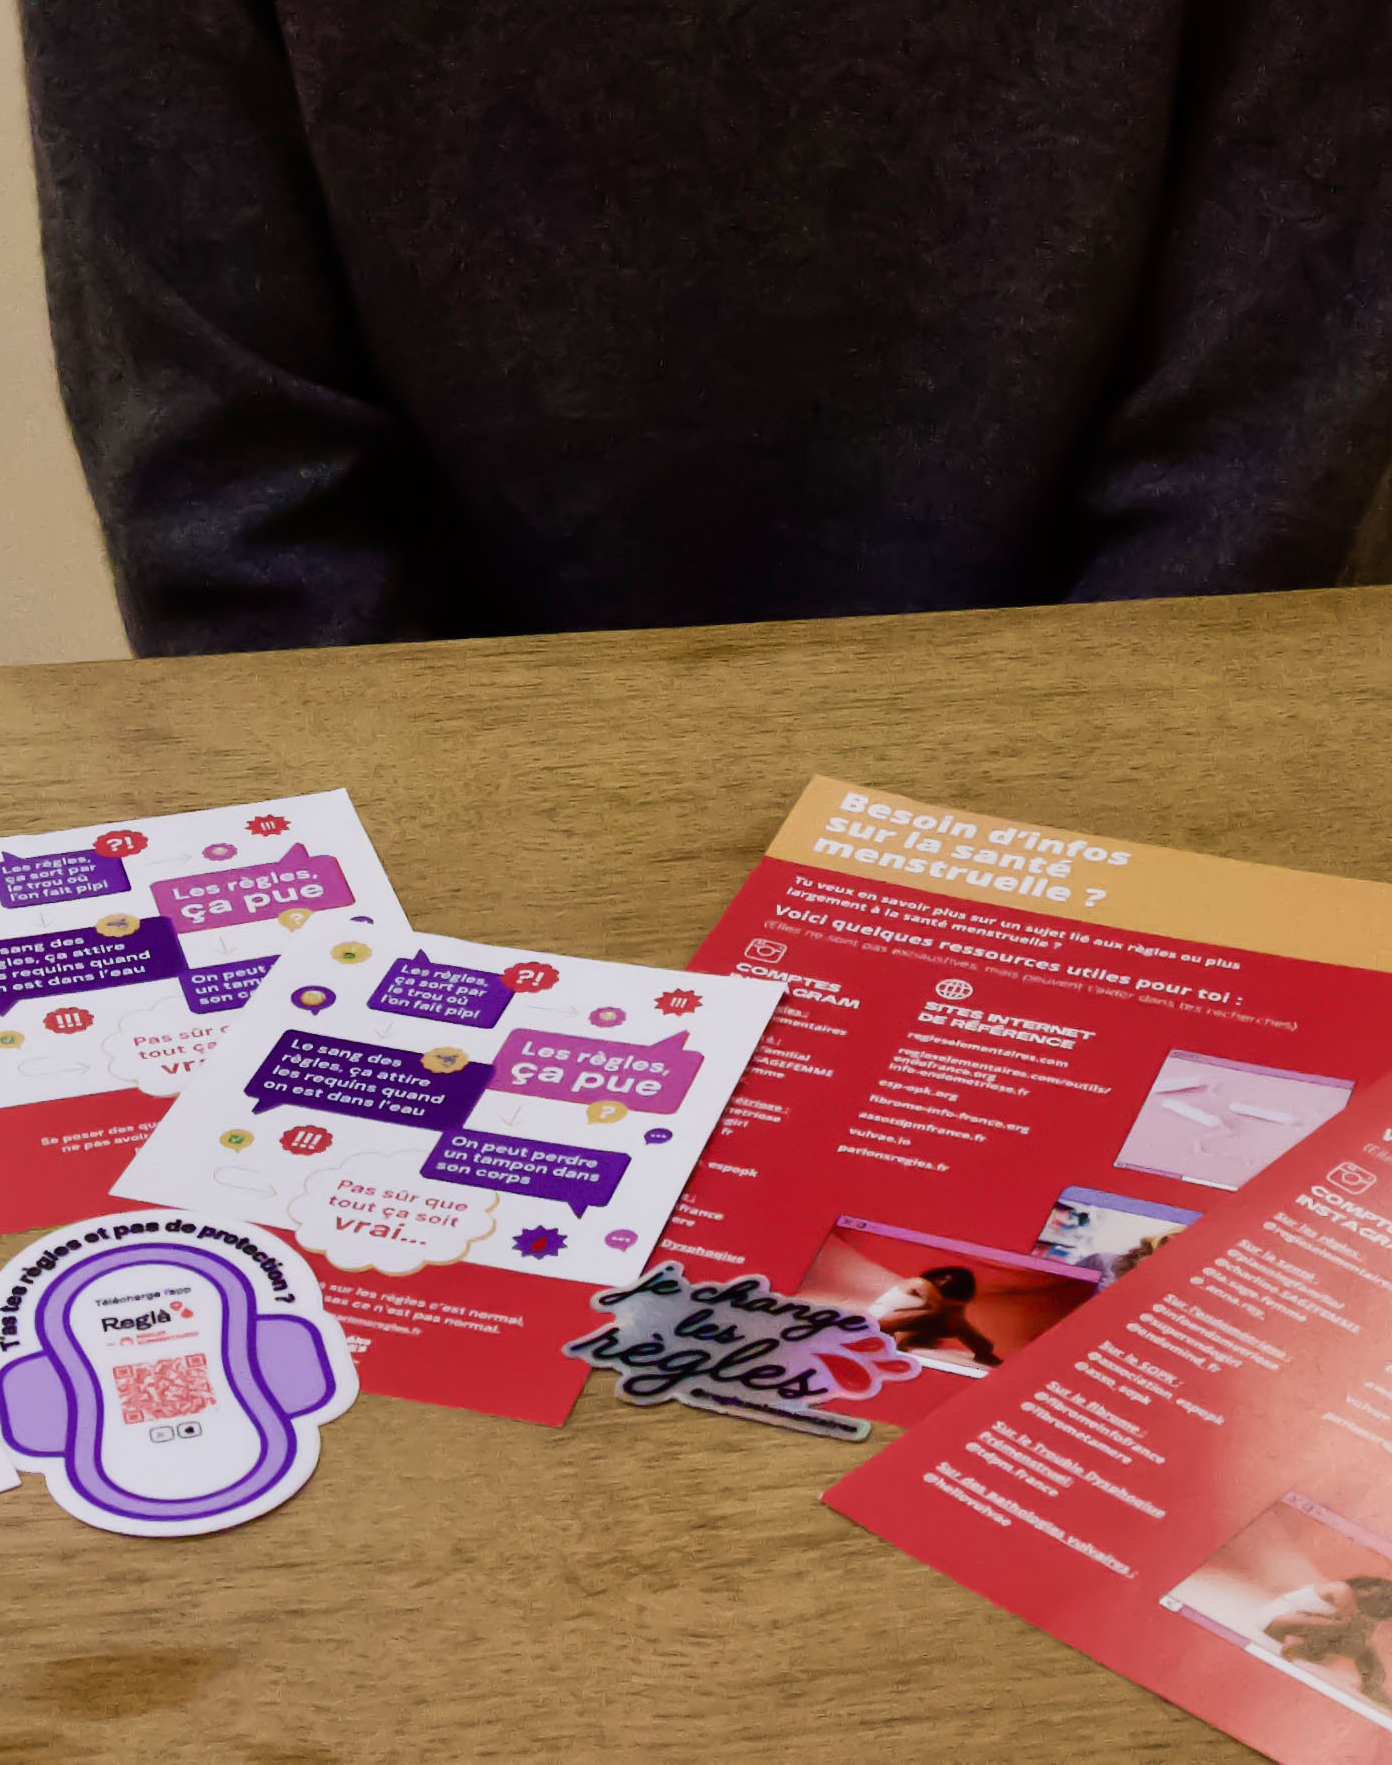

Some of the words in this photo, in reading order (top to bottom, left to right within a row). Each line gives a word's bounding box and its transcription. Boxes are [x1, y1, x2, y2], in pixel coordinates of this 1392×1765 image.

[838, 791, 977, 839] Besoin
[824, 816, 897, 843] sur
[902, 830, 942, 854] la
[950, 844, 1072, 878] santé
[172, 883, 220, 900] Les
[226, 869, 318, 891] règles,
[813, 837, 1071, 901] menstruelle
[1084, 887, 1106, 907] ?
[180, 898, 232, 924] ça
[242, 883, 324, 913] pue
[795, 875, 813, 887] Tu
[816, 881, 854, 896] veux
[880, 896, 930, 911] savoir
[931, 907, 966, 919] plus
[969, 914, 997, 925] sur
[1024, 925, 1066, 939] sujet
[1092, 938, 1123, 949] aux
[1126, 943, 1176, 959] règles
[1203, 957, 1240, 970] plus
[43, 951, 67, 963] ça
[72, 943, 125, 957] attire
[49, 936, 84, 948] des
[775, 903, 828, 925] Voici
[831, 919, 933, 947] quelques
[938, 940, 1060, 972] ressources
[1066, 965, 1131, 984] utiles
[1134, 978, 1192, 995] pour
[1197, 988, 1230, 1003] toi
[11, 962, 85, 978] requins
[89, 949, 151, 969] quand
[190, 973, 218, 984] On
[221, 965, 266, 981] peut
[400, 963, 430, 977] Les
[734, 961, 842, 993] COMPTES
[11, 979, 43, 990] est
[47, 973, 95, 986] dans
[387, 983, 403, 994] le
[407, 987, 443, 1001] trou
[394, 976, 415, 985] ça
[418, 979, 454, 991] sort
[454, 985, 486, 996] par
[412, 999, 442, 1013] fait
[443, 1006, 481, 1019] pipi
[924, 1000, 983, 1019] SITES
[986, 1012, 1096, 1039] INTERNET
[917, 1011, 947, 1024] DE
[949, 1017, 1076, 1049] RÉFÉRENCE
[290, 1038, 313, 1051] Le
[316, 1045, 363, 1062] sang
[366, 1053, 402, 1067] des
[520, 1040, 570, 1060] Les
[576, 1050, 669, 1076] règles,
[271, 1064, 300, 1078] les
[303, 1072, 377, 1092] requins
[380, 1086, 445, 1104] quand
[281, 1053, 343, 1073] règles,
[348, 1066, 373, 1077] ça
[376, 1071, 431, 1087] attire
[510, 1061, 564, 1085] ça
[570, 1070, 662, 1096] pue
[263, 1080, 287, 1091] on
[291, 1085, 323, 1098] est
[326, 1090, 374, 1107] dans
[107, 1125, 134, 1134] des
[443, 1149, 468, 1160] un
[472, 1152, 548, 1174] tampon
[552, 1166, 599, 1182] dans
[451, 1135, 478, 1149] On
[480, 1142, 528, 1157] peut
[529, 1150, 598, 1168] perdre
[435, 1161, 471, 1174] son
[475, 1168, 531, 1184] corps
[328, 1194, 376, 1213] tout
[381, 1206, 409, 1219] ça
[415, 1212, 459, 1227] soit
[336, 1179, 376, 1195] Pas
[381, 1189, 419, 1203] sûr
[424, 1197, 468, 1211] que
[335, 1215, 426, 1245] vrai...
[20, 1236, 82, 1284] règles
[113, 1221, 159, 1240] pas
[165, 1219, 197, 1234] de
[197, 1225, 289, 1293] protection
[599, 1265, 682, 1305] je
[691, 1280, 869, 1342] change
[674, 1308, 745, 1343] les
[570, 1327, 828, 1398] règles
